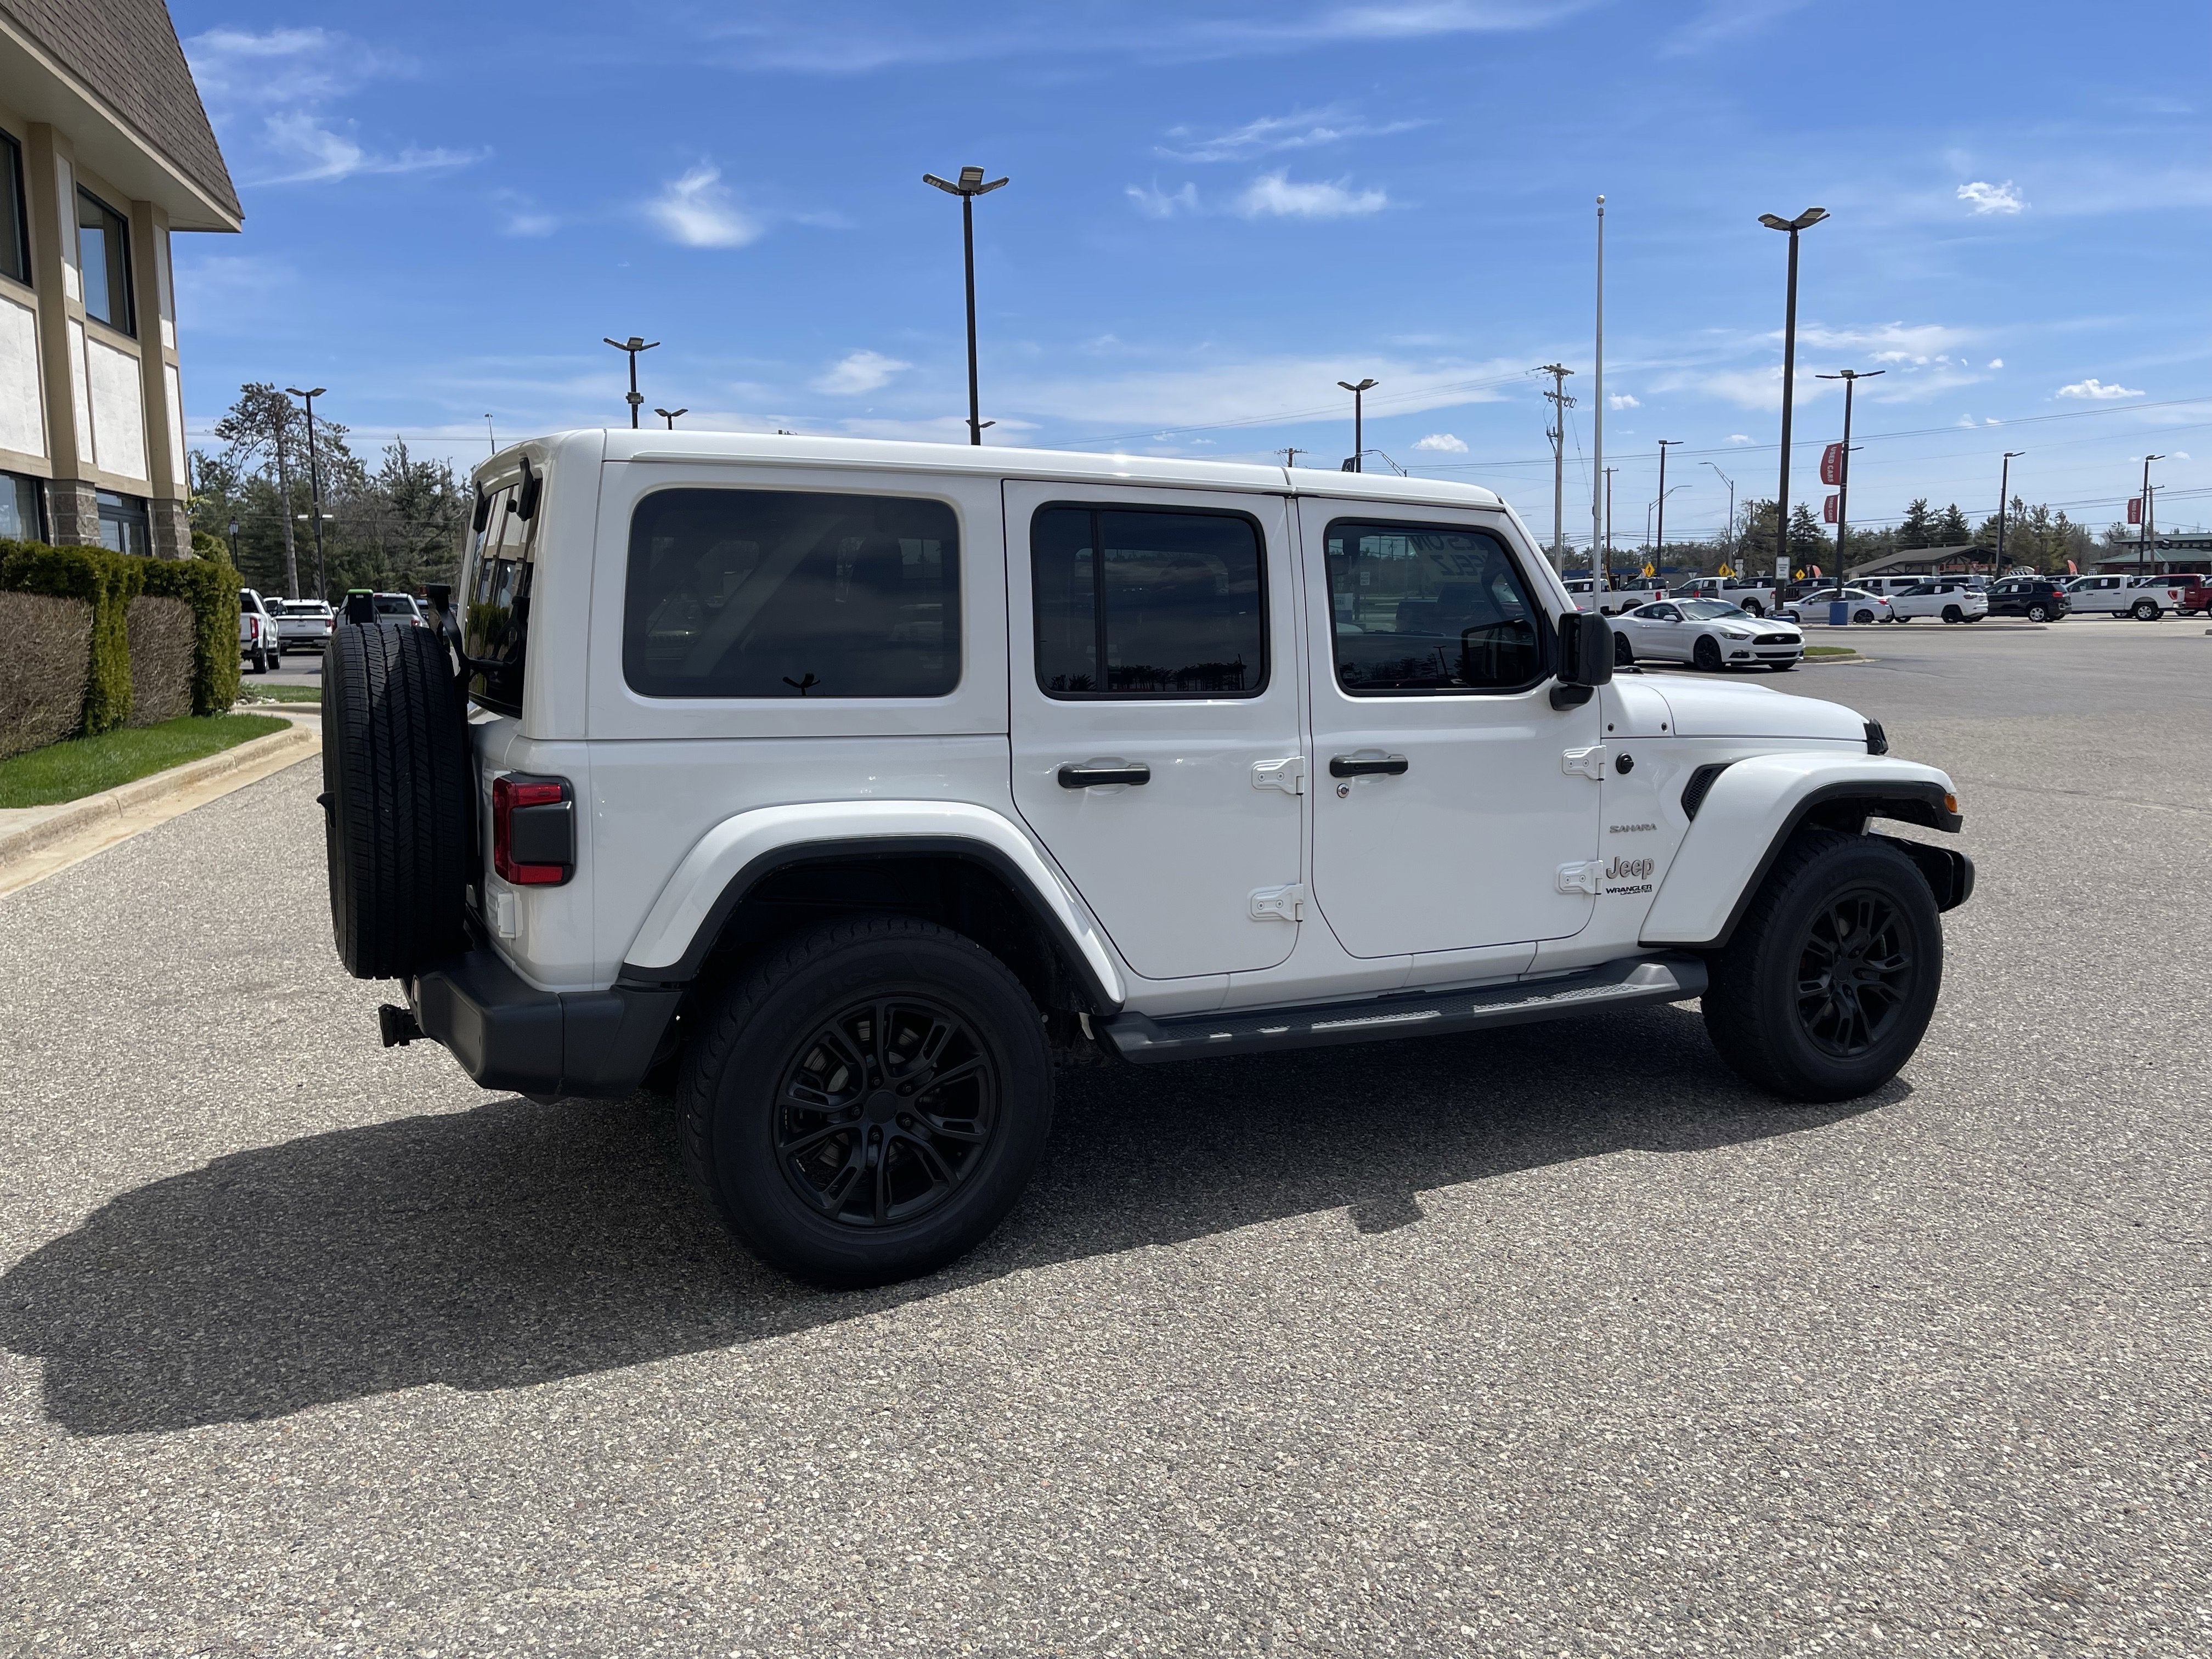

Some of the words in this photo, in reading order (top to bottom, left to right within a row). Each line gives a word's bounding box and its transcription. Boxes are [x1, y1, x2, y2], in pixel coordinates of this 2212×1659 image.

[1828, 447, 1837, 464] USED
[1610, 823, 1657, 833] SAHARA
[1606, 856, 1655, 879] Jeep
[1606, 884, 1652, 894] WRANGLER
